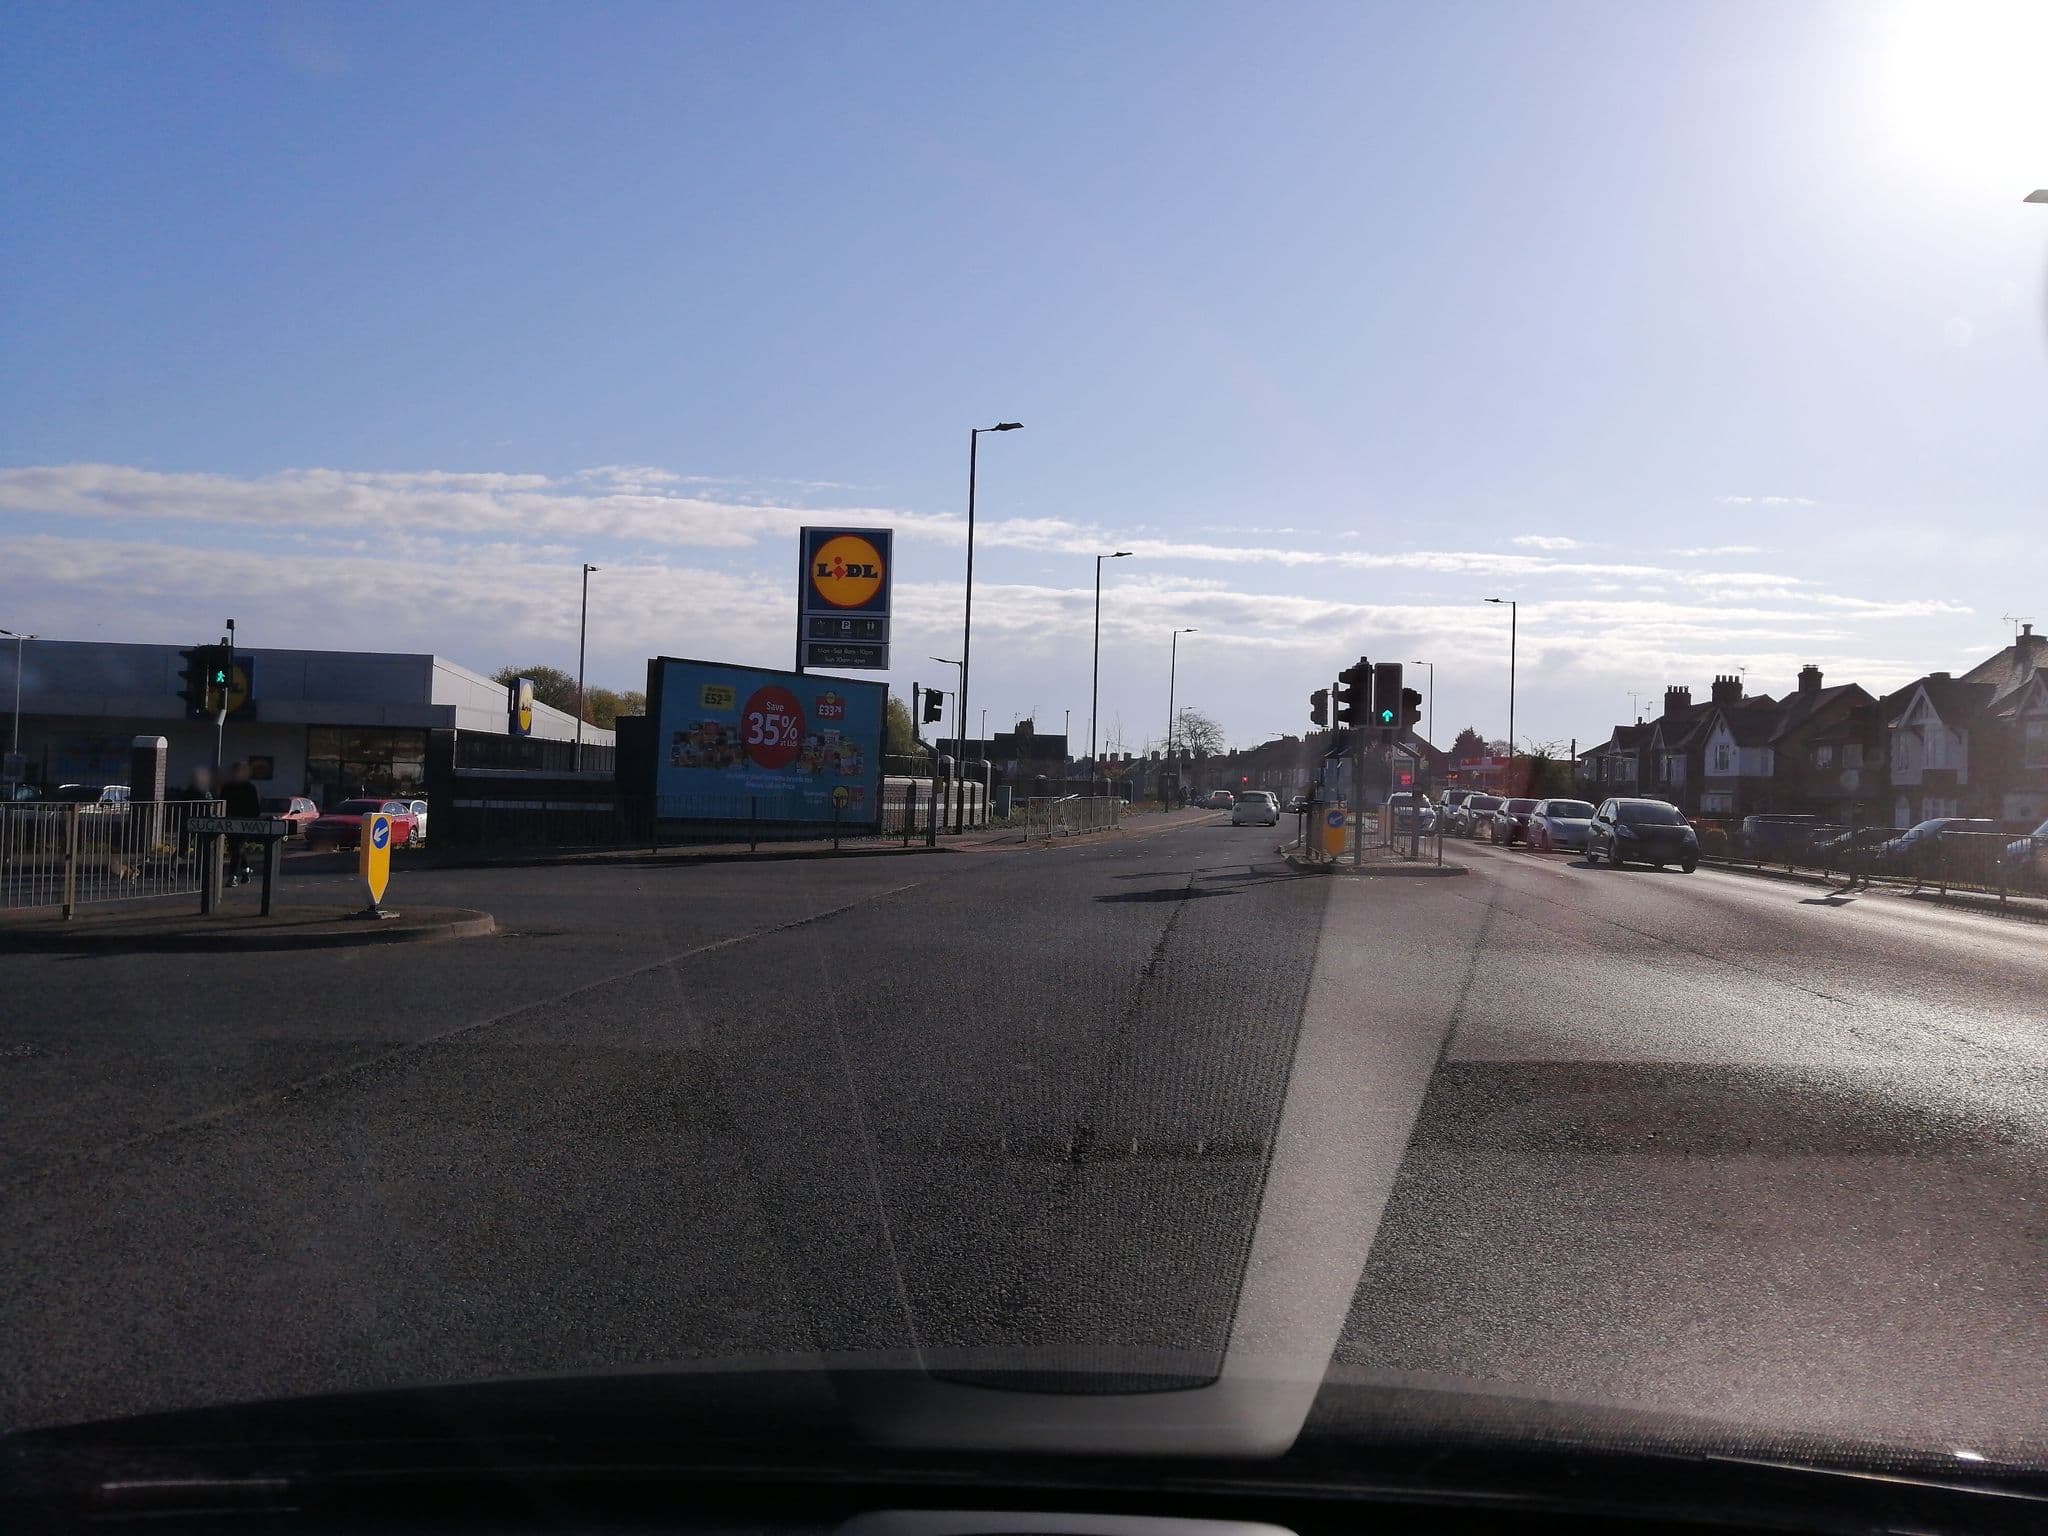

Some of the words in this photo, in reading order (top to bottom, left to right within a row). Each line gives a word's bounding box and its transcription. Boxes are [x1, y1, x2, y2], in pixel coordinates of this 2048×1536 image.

[766, 701, 785, 712] Save
[747, 712, 798, 746] 35%
[189, 819, 234, 832] SUGAR
[240, 821, 269, 833] WAY
